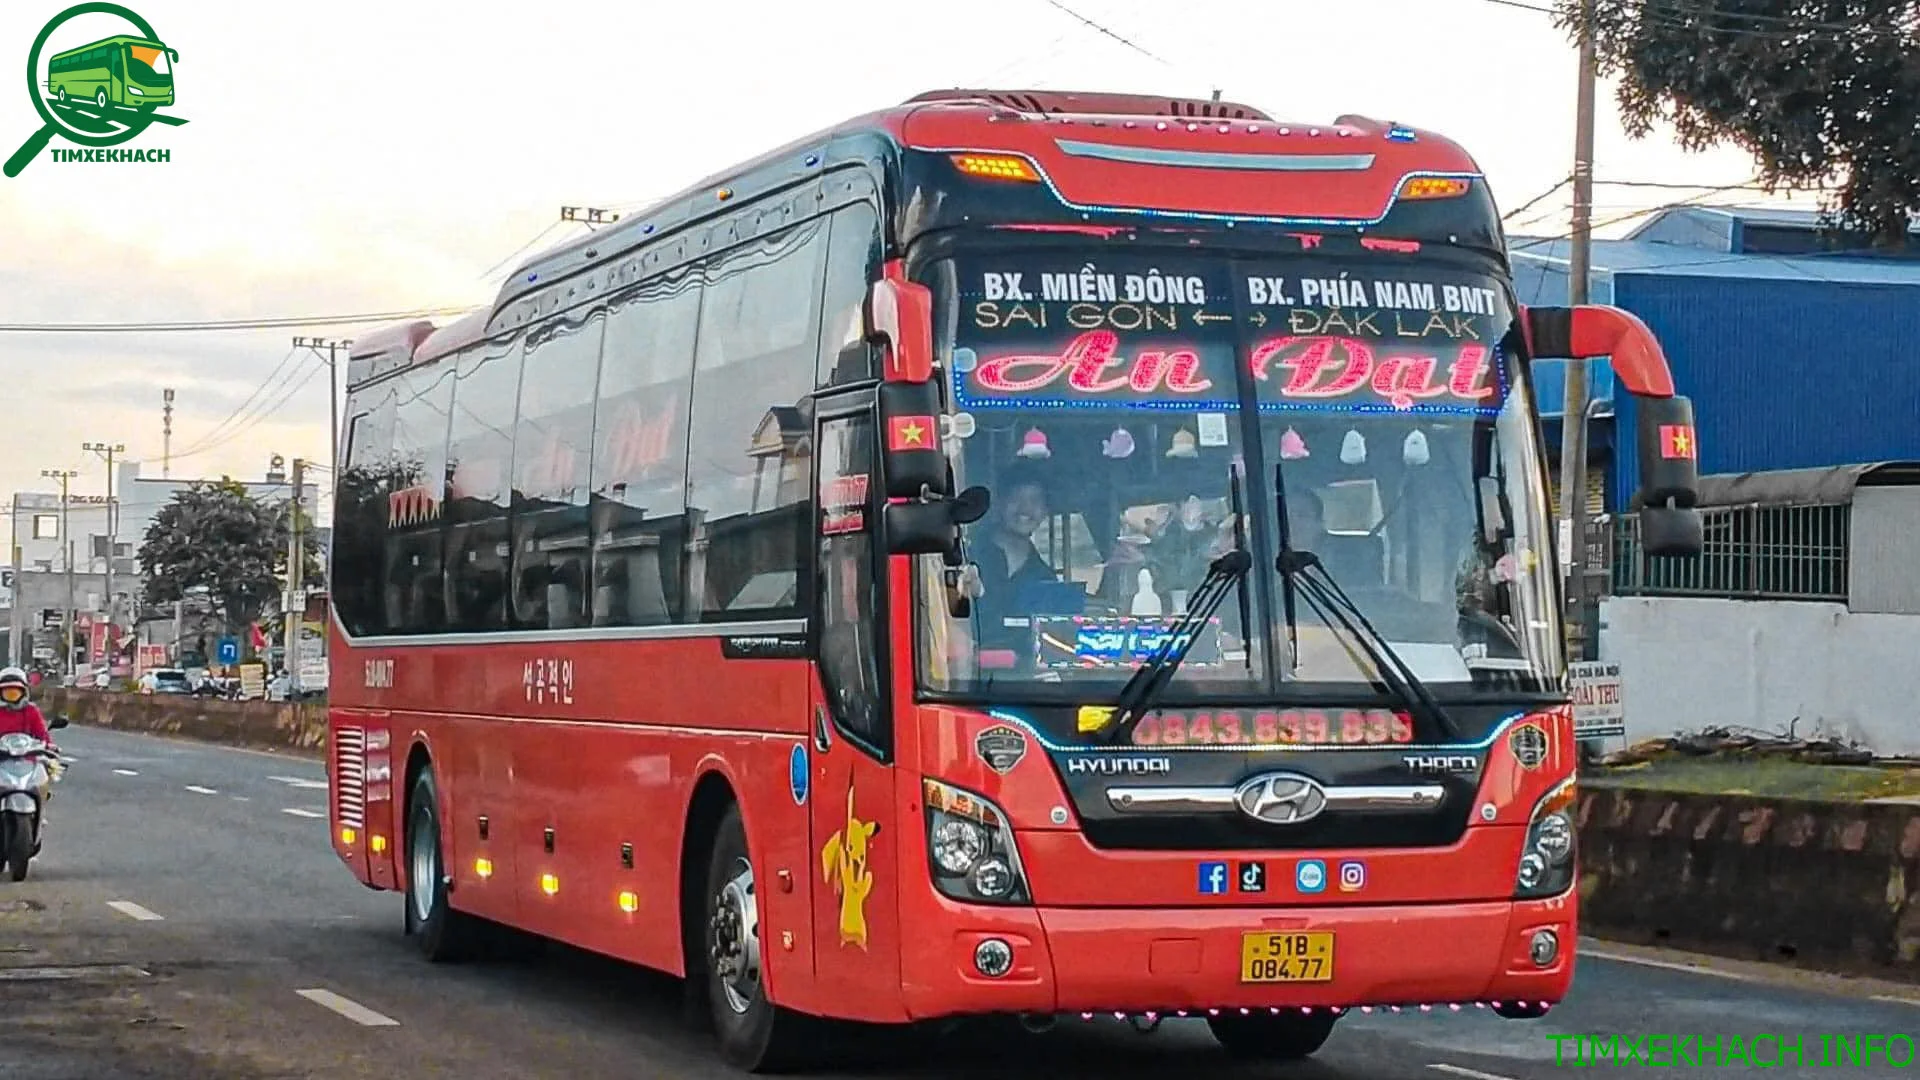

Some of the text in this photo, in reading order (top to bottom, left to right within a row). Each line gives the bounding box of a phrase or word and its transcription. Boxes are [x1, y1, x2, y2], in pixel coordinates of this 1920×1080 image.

[983, 263, 1205, 304] BX. MIỀN ĐÔNG
[1247, 271, 1496, 316] BX. PHÍA NAM BMT
[975, 329, 1493, 411] An Đạt
[523, 658, 573, 704] 성공적인
[1068, 757, 1170, 776] HYUNDAI
[1404, 755, 1478, 772] THACO
[1269, 936, 1308, 956] 51B
[1251, 959, 1324, 979] 084.77
